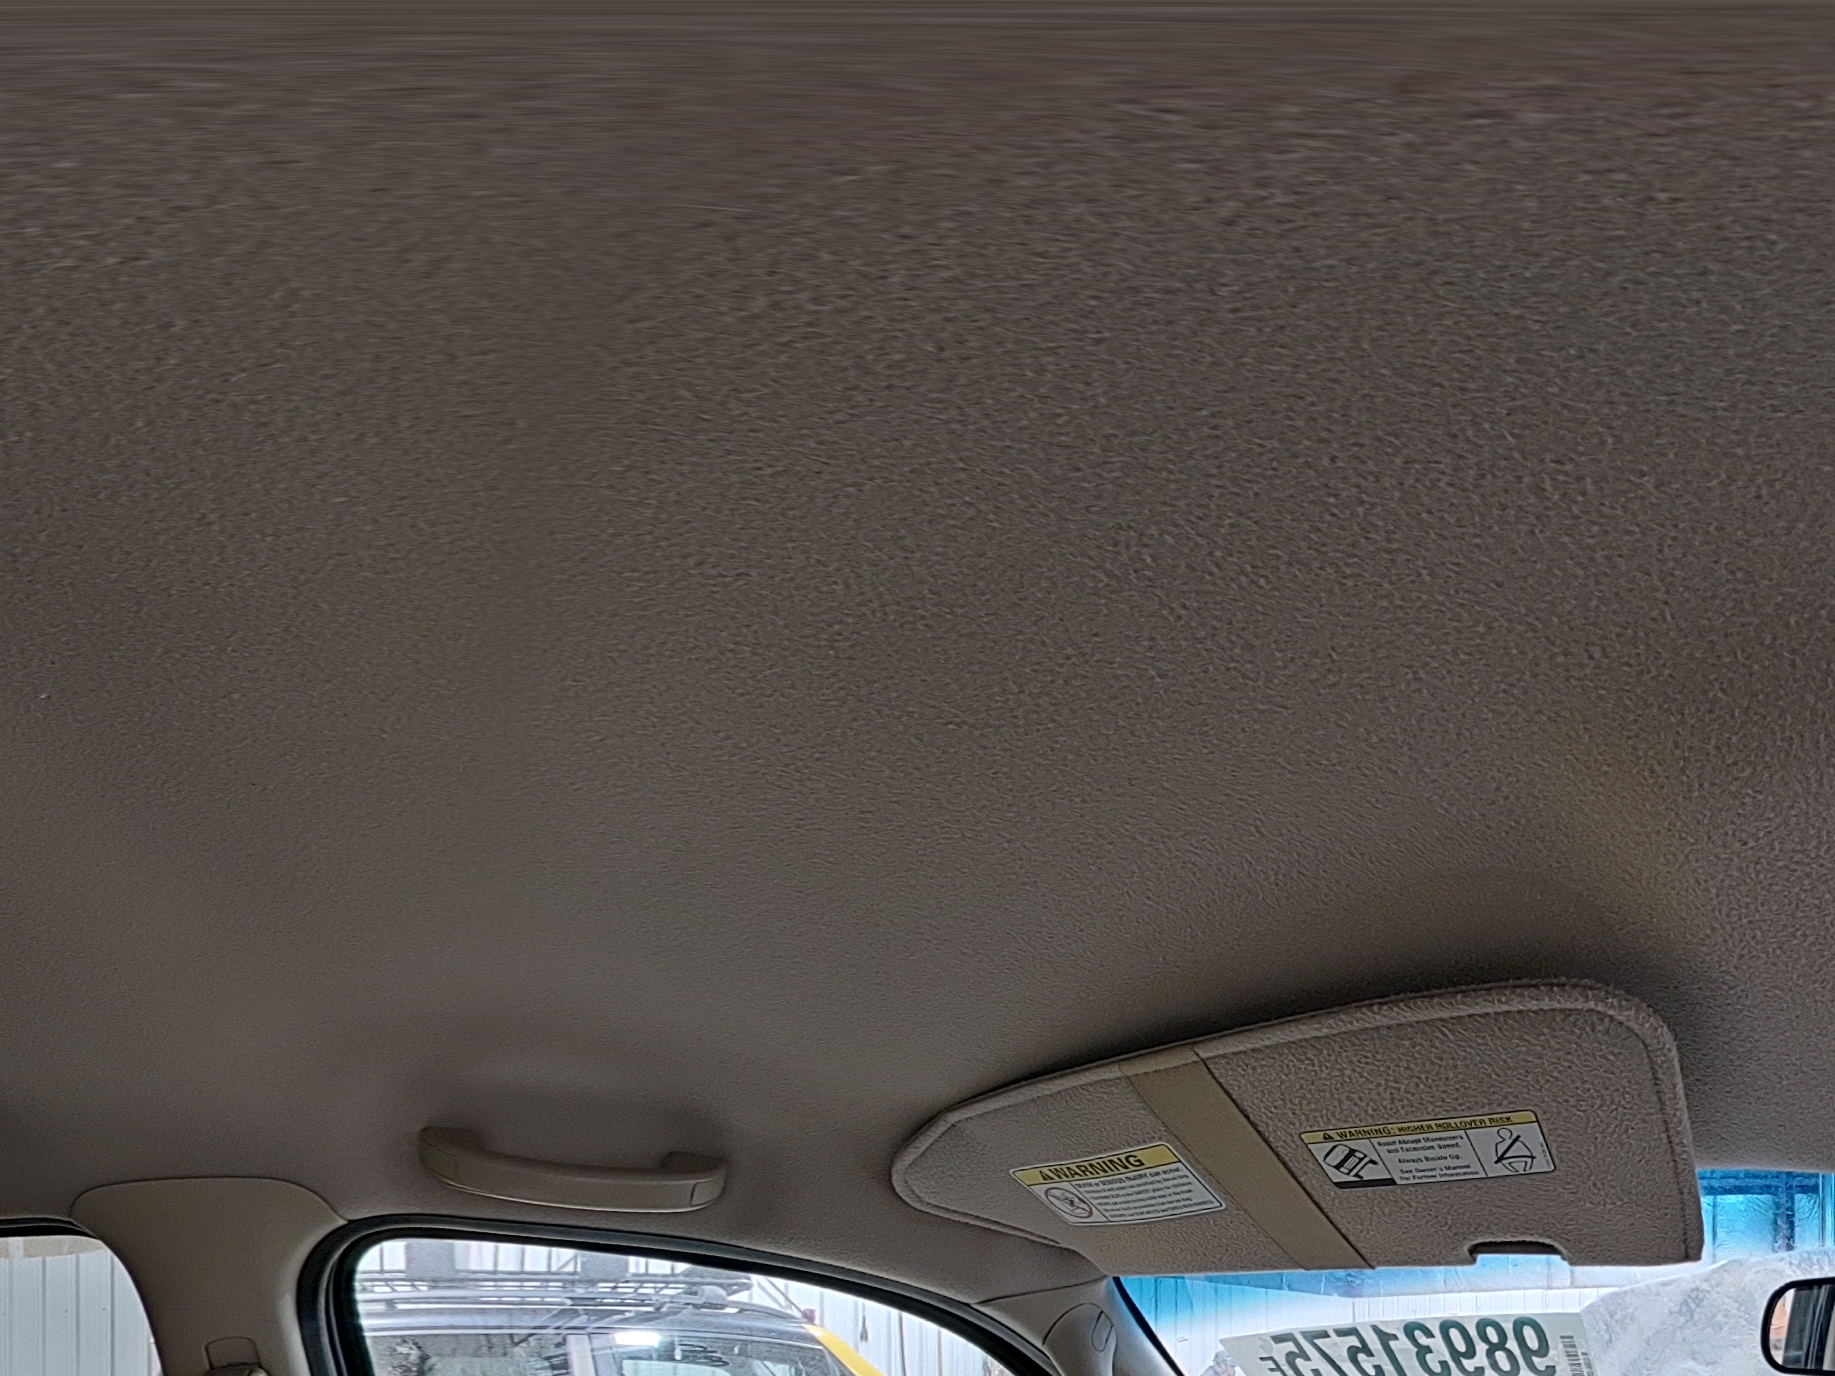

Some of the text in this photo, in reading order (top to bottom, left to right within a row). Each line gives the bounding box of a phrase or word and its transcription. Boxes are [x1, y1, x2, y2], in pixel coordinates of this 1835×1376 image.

[1398, 1124, 1433, 1134] HIGHER
[1434, 1118, 1485, 1130] ROLLOVER
[1488, 1115, 1513, 1125] RISK
[1047, 1154, 1146, 1182] WARNING
